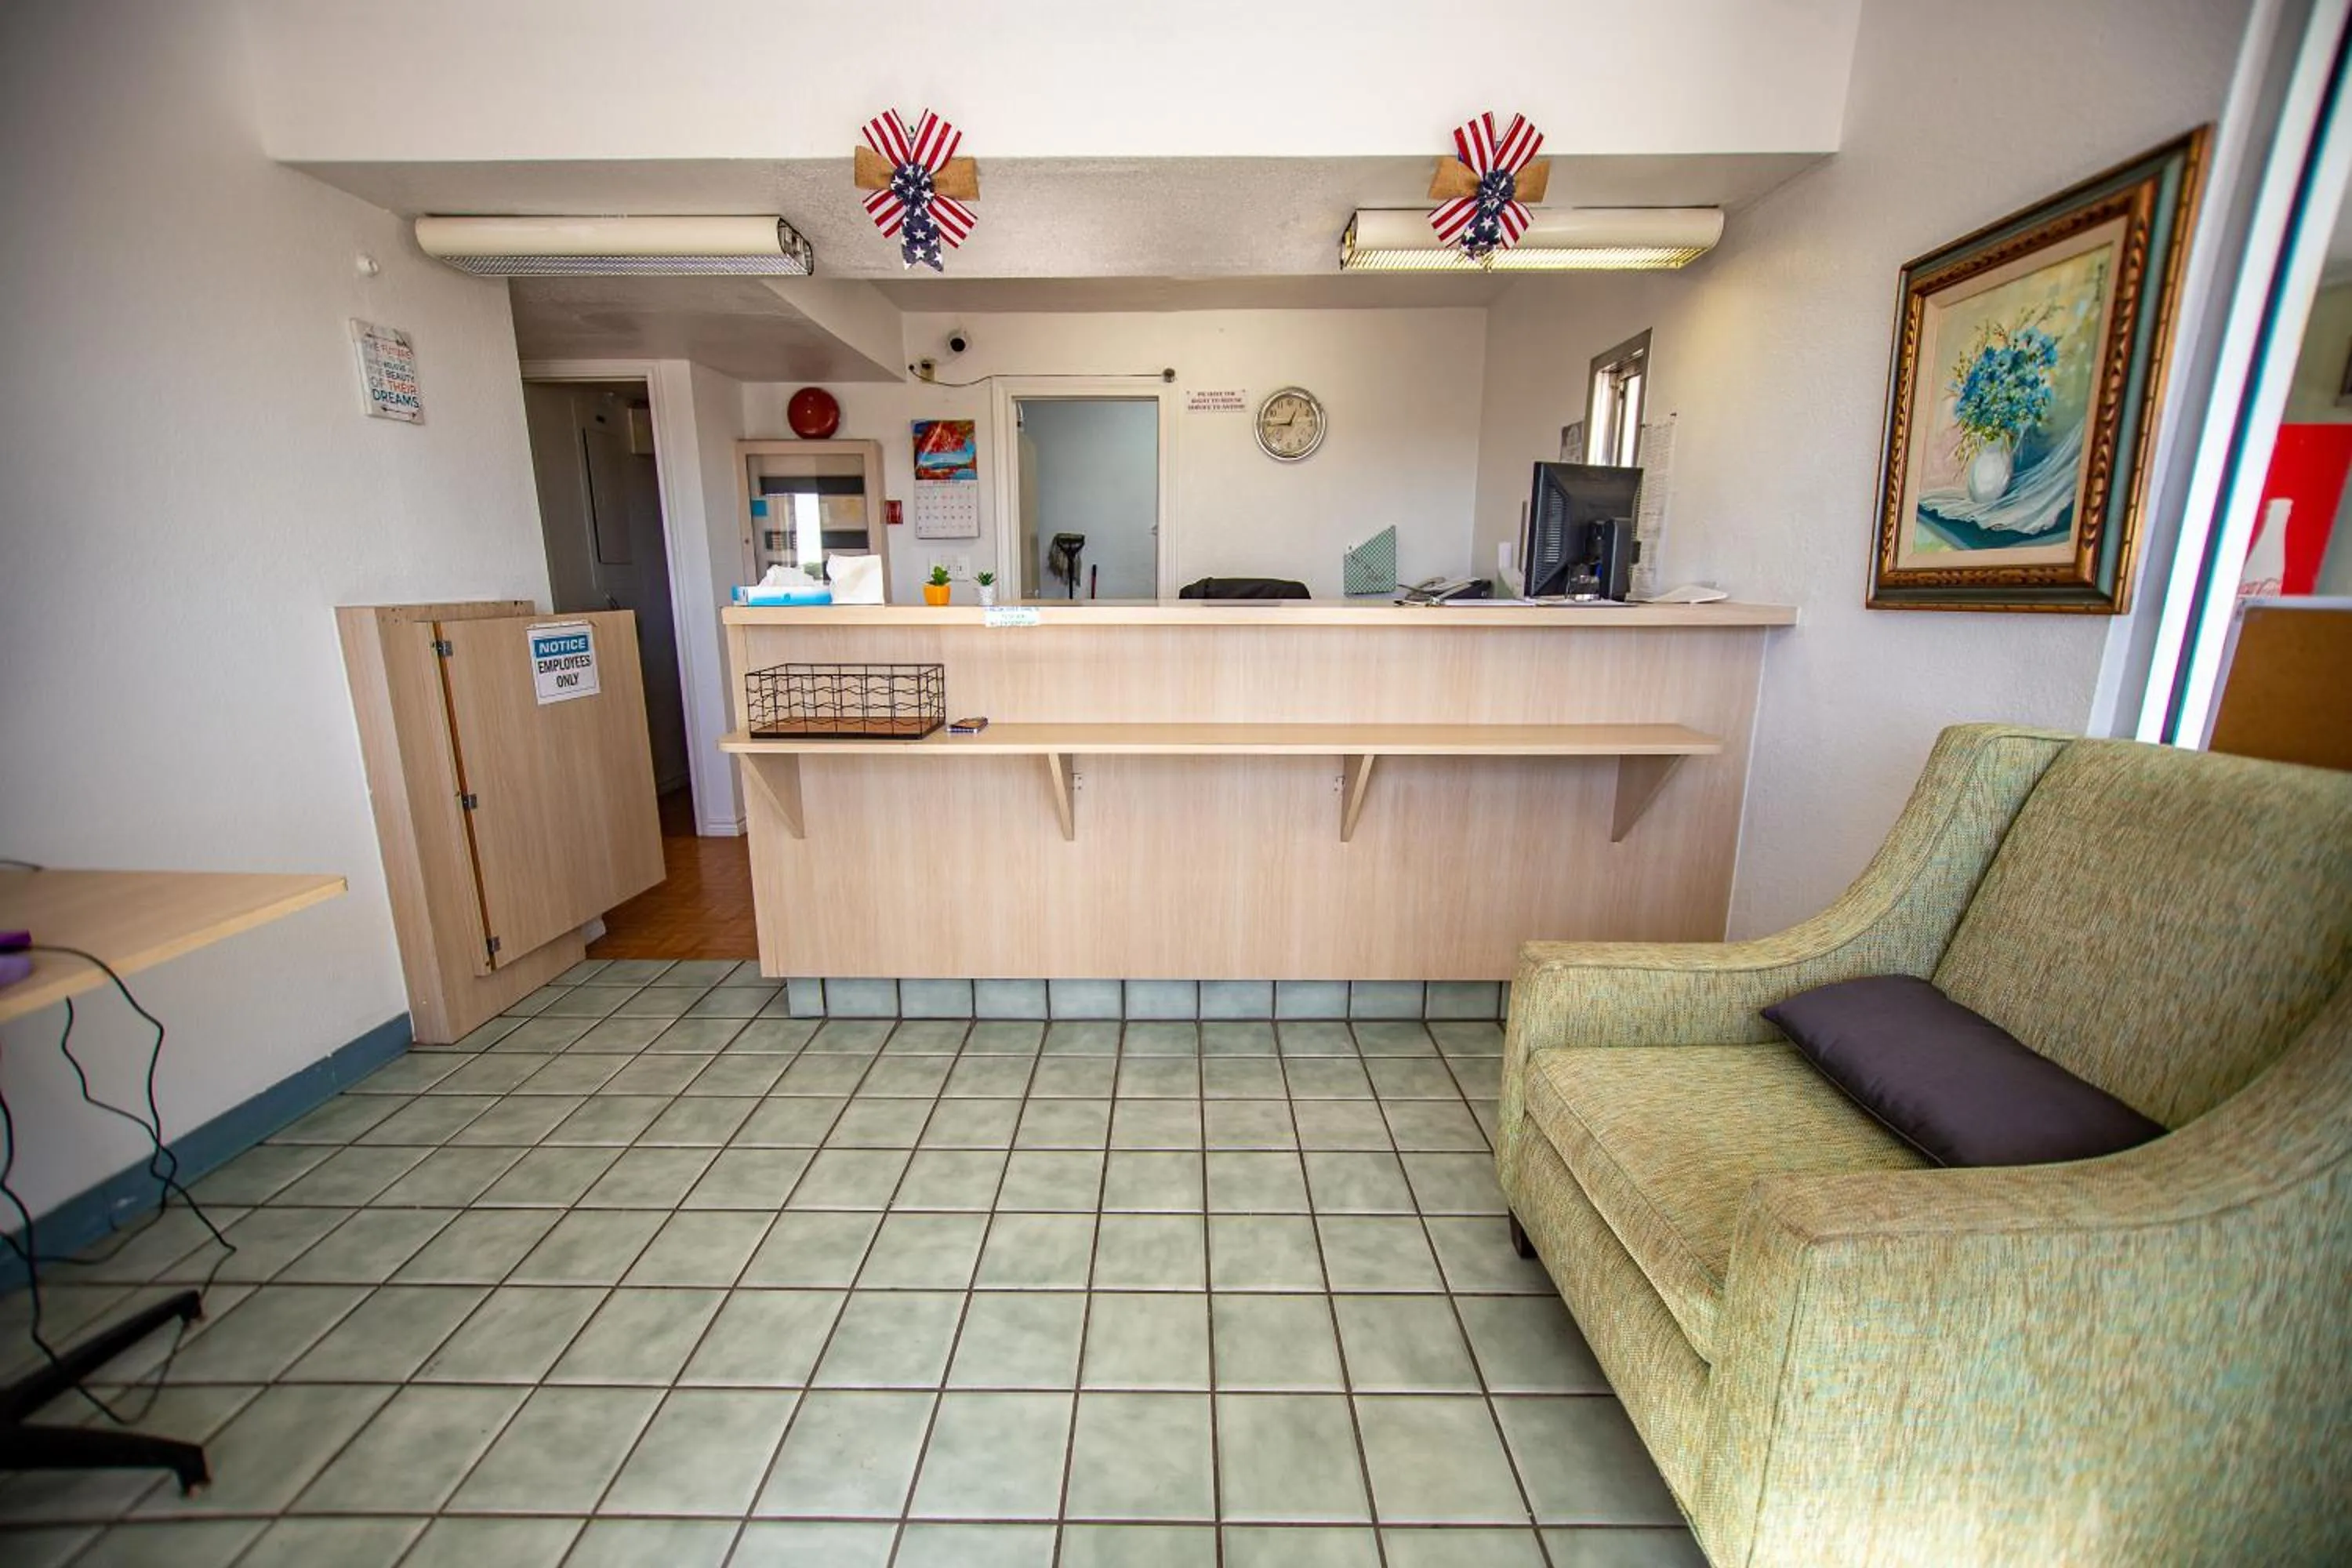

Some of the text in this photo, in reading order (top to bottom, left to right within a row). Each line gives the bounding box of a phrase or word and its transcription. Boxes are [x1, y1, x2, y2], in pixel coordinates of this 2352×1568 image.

[372, 389, 419, 408] DREAMS
[539, 638, 586, 653] NOTICE
[538, 655, 590, 674] EMPLOYEES
[556, 672, 580, 688] ONLY
